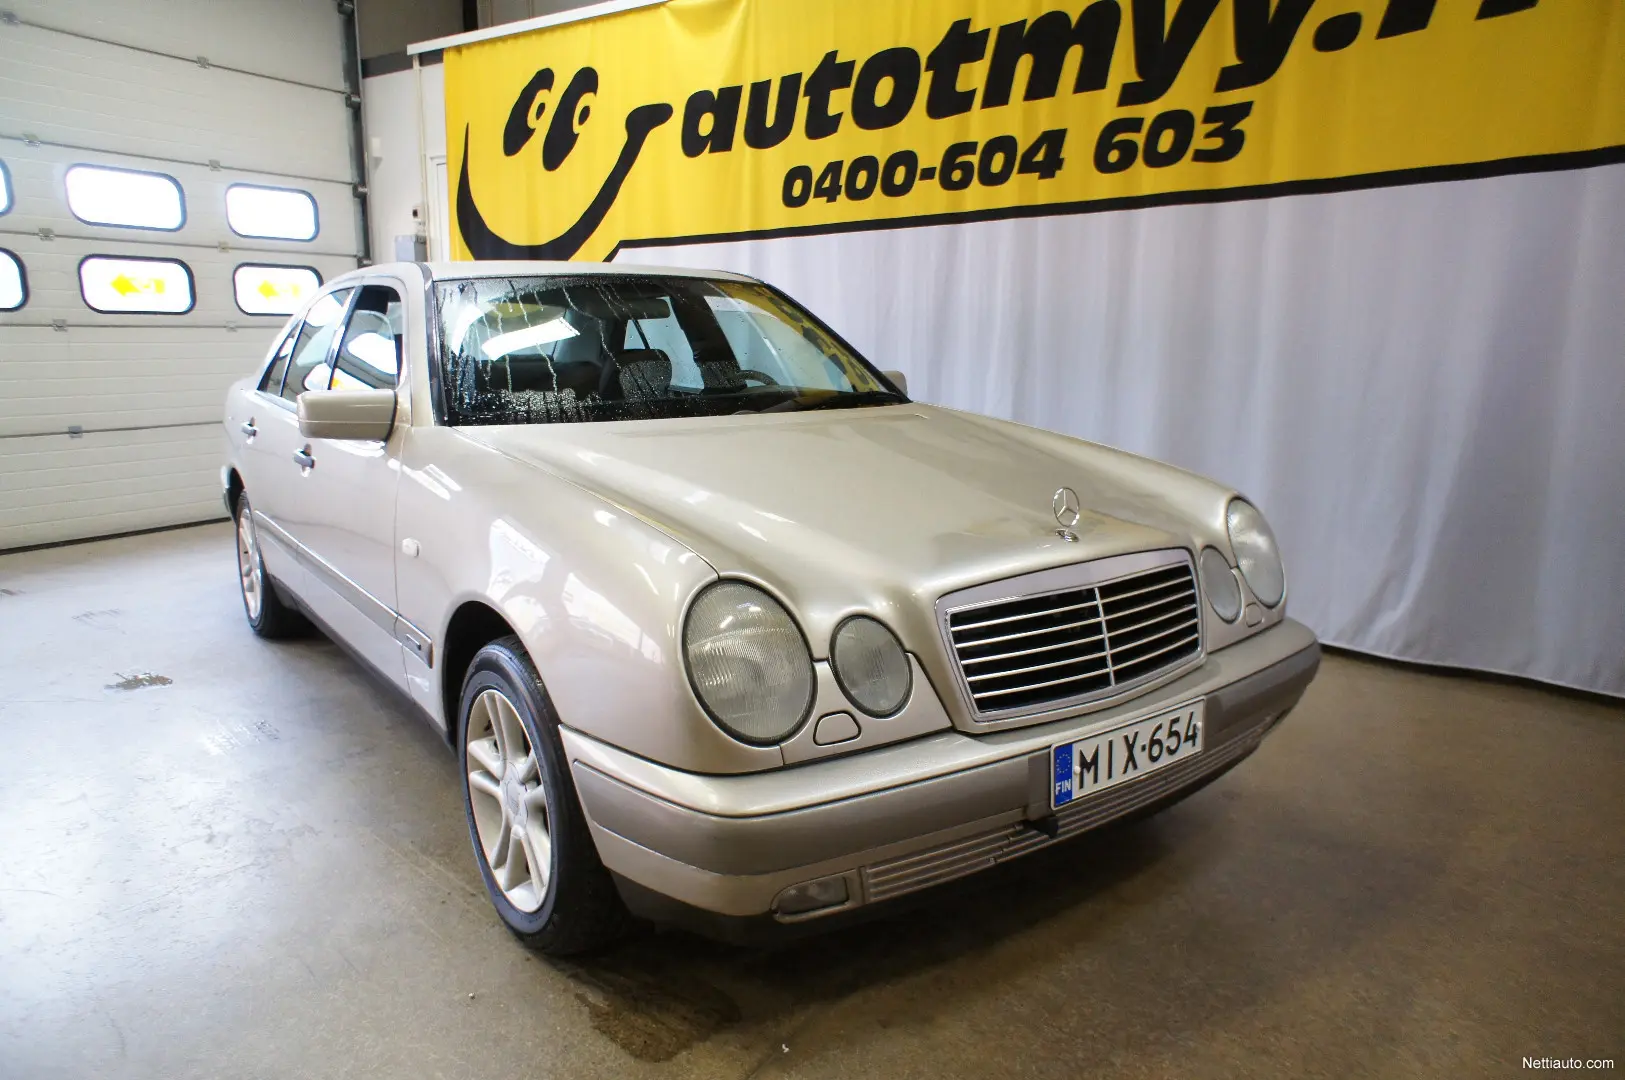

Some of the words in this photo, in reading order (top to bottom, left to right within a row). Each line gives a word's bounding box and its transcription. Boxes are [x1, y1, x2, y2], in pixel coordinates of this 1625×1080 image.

[681, 0, 1540, 157] autotmyy.
[782, 128, 1068, 208] 0400-604
[1094, 101, 1254, 174] 603
[1055, 778, 1072, 796] FIN
[1078, 711, 1199, 790] MIX-654
